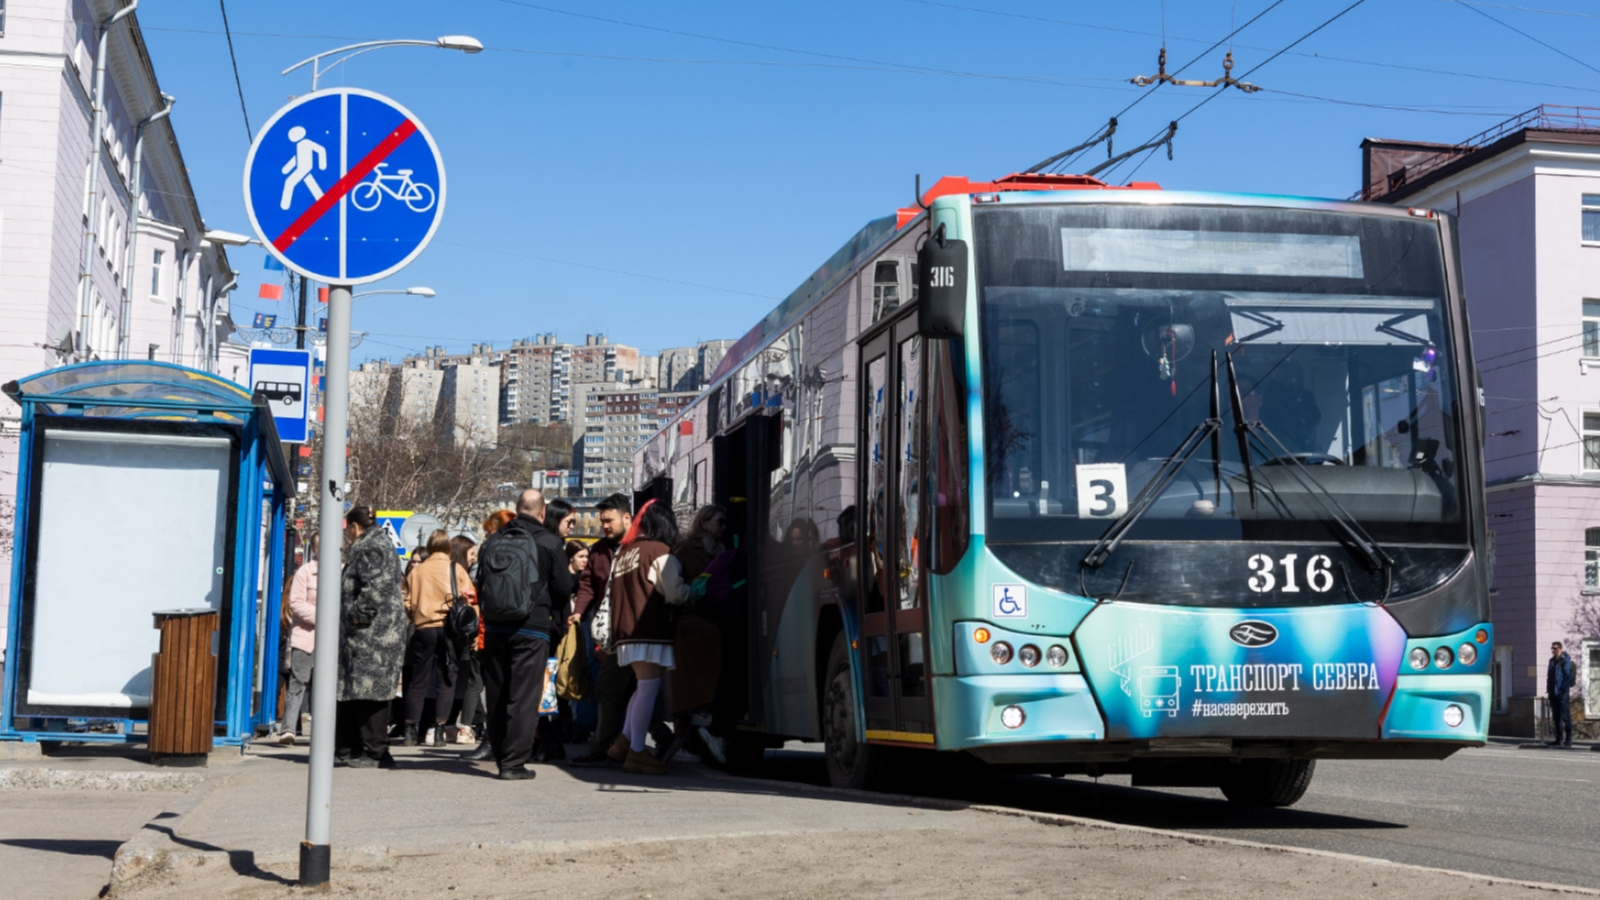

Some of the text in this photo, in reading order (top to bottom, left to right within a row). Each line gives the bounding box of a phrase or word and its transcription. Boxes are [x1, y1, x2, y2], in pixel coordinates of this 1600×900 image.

[930, 266, 954, 287] 316
[1089, 479, 1117, 518] 3
[1247, 553, 1334, 593] 316
[1190, 662, 1380, 693] ТРАНСПОРТ СЕВЕРА
[1191, 699, 1290, 719] #насевережить
